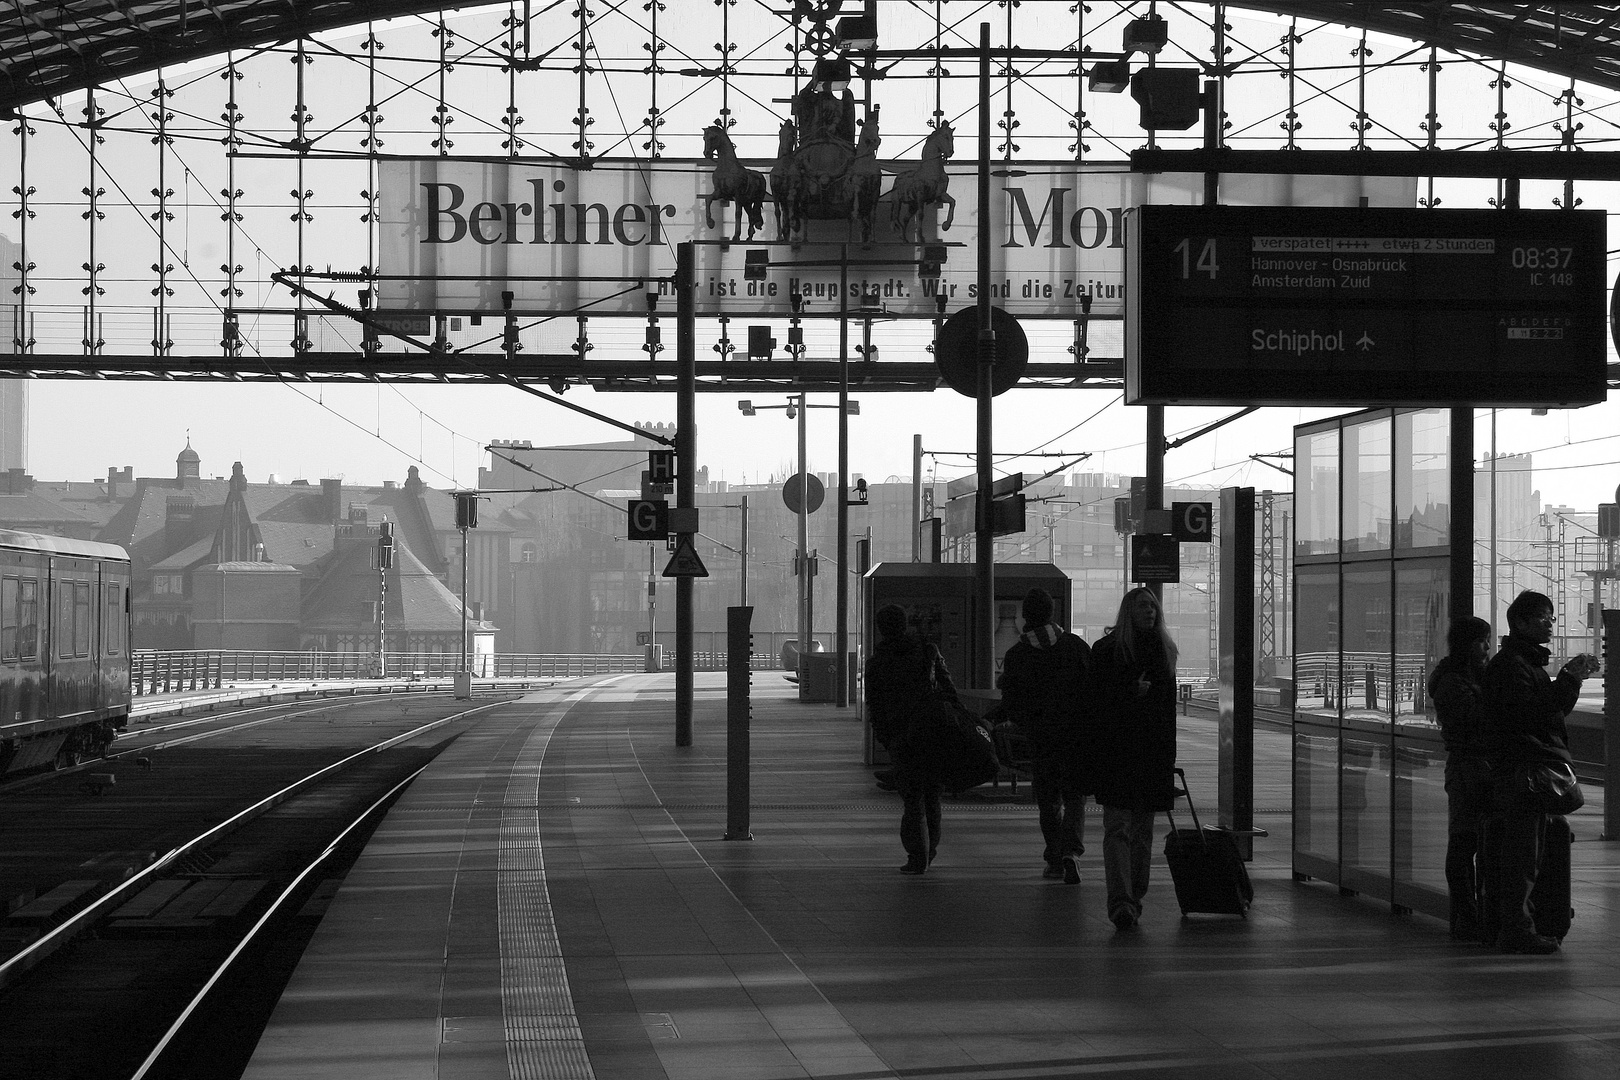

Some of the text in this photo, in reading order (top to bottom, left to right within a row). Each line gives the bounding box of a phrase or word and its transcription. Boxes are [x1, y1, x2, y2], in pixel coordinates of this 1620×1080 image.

[420, 179, 676, 246] Berliner
[1382, 239, 1420, 250] etwa
[1424, 239, 1432, 250] 2
[1436, 239, 1494, 250] Stunden
[1173, 238, 1219, 280] 14
[1252, 257, 1318, 271] Hannover
[1332, 257, 1407, 271] Osnabrück
[1512, 247, 1574, 269] 08:37
[709, 277, 737, 297] ist
[747, 278, 778, 297] die
[921, 278, 957, 298] Wir
[968, 279, 1011, 298] snd
[1022, 279, 1052, 298] die
[1252, 275, 1370, 288] Amsterdam Zuid
[1530, 274, 1573, 287] IC 148
[1252, 329, 1345, 357] Schiphol
[653, 454, 669, 478] H
[633, 501, 656, 532] G
[1184, 503, 1207, 534] G
[668, 536, 677, 548] H
[1181, 686, 1190, 699] H
